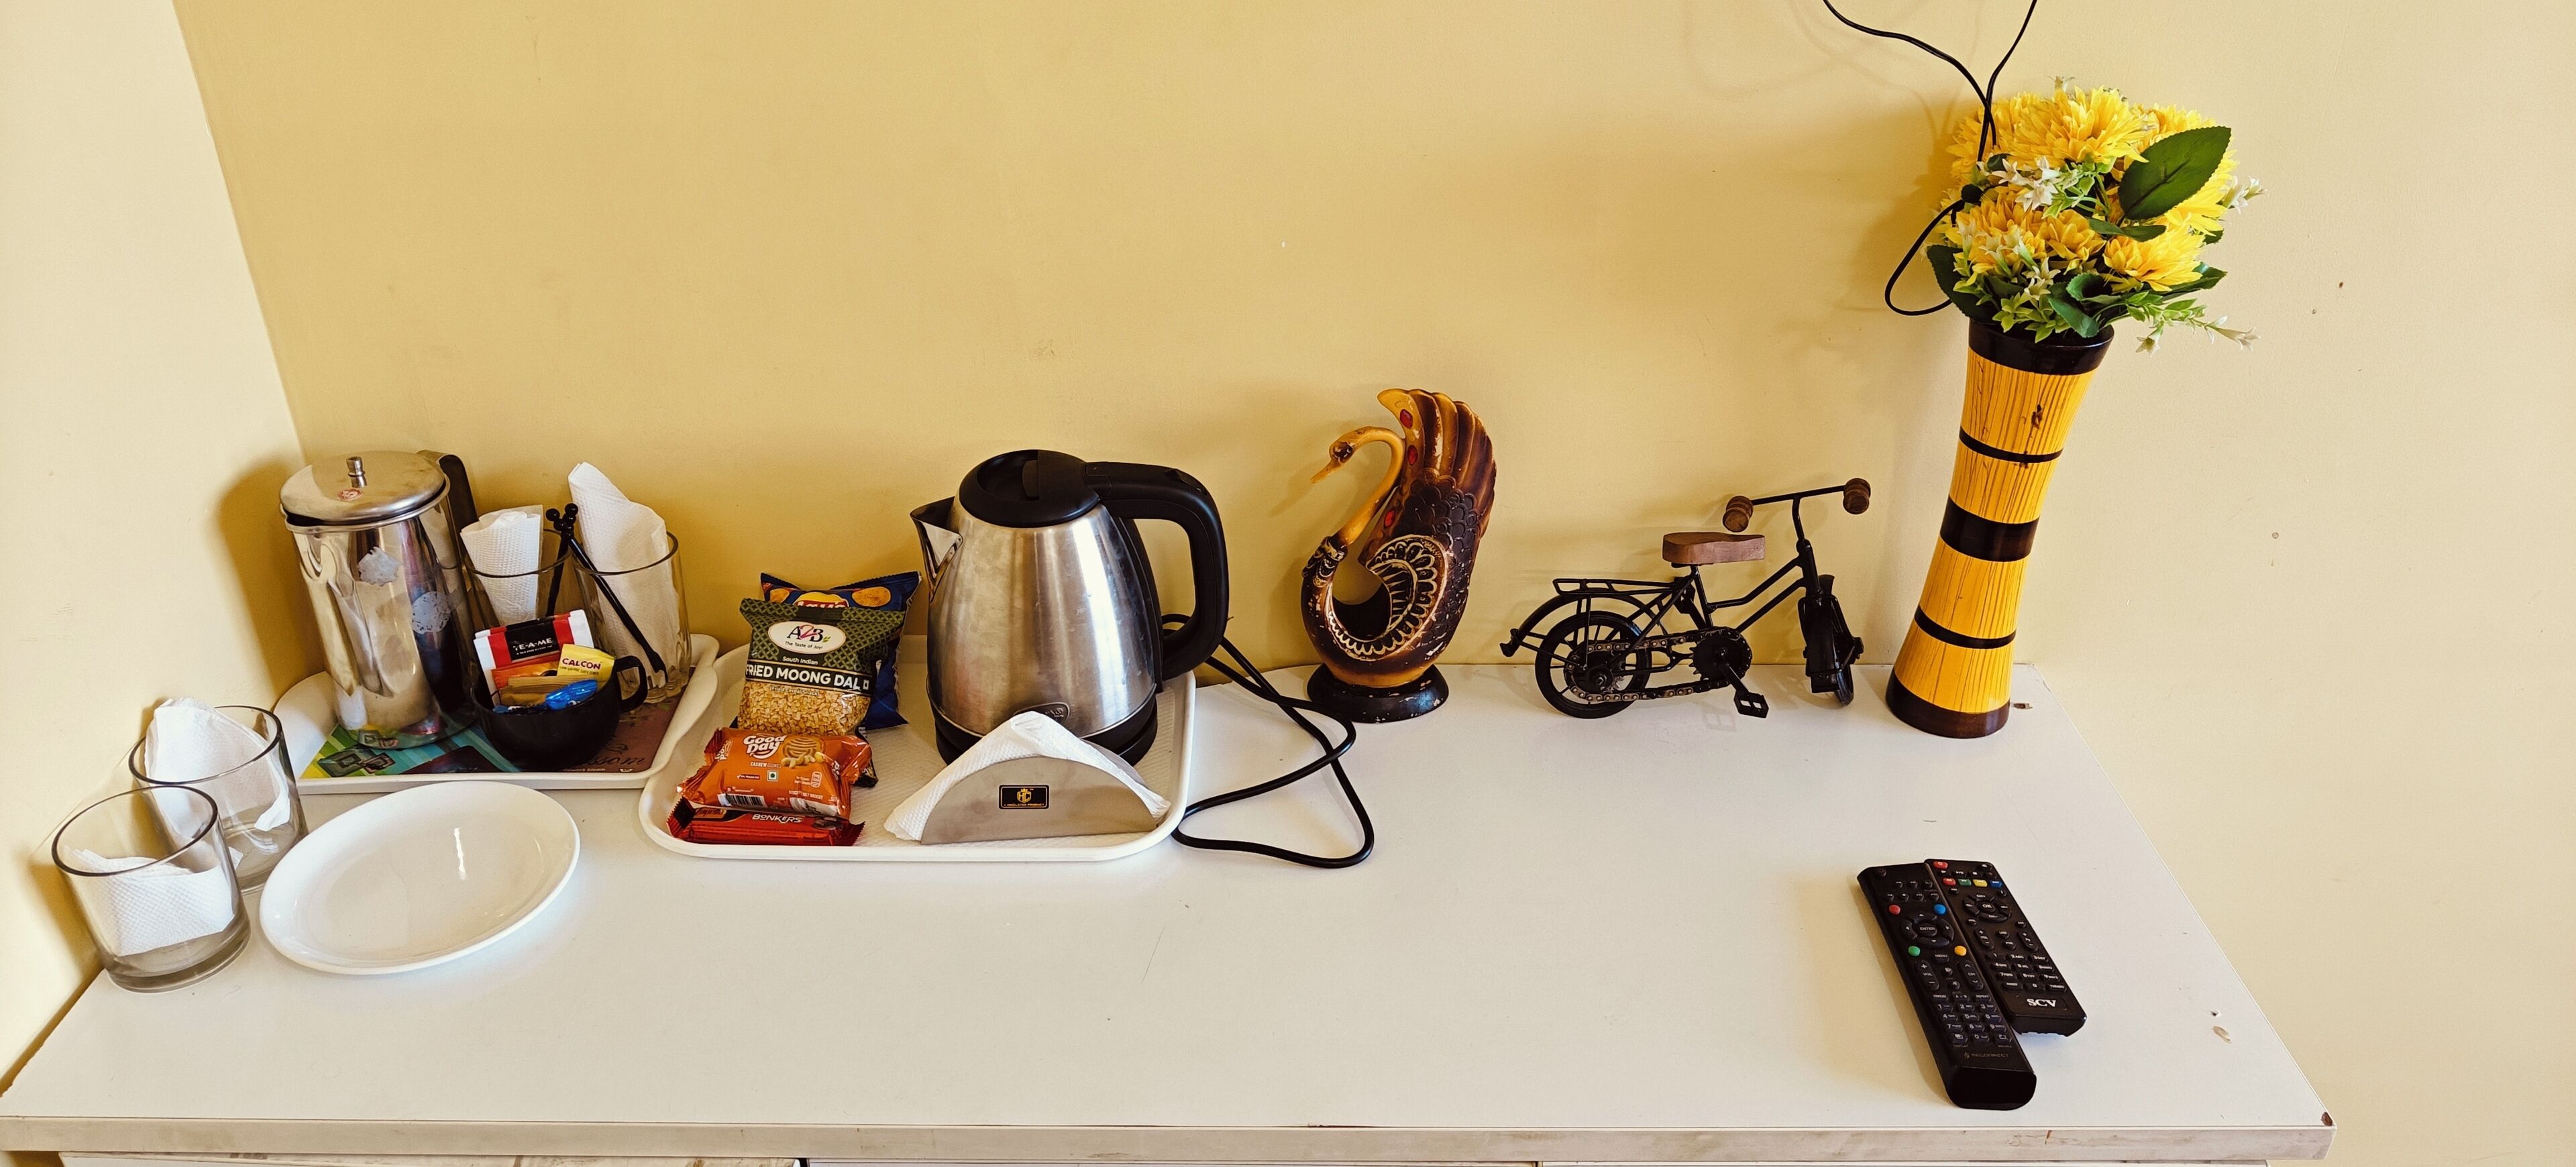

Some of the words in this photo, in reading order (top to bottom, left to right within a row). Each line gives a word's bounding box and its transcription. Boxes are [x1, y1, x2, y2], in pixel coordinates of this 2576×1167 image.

[787, 624, 824, 642] A2B
[562, 658, 601, 670] CALCON
[745, 664, 773, 677] FRIED
[775, 667, 831, 685] MOONG
[833, 674, 861, 690] DAL
[743, 735, 788, 744] Good
[746, 741, 780, 759] Day
[2027, 998, 2057, 1007] SCV
